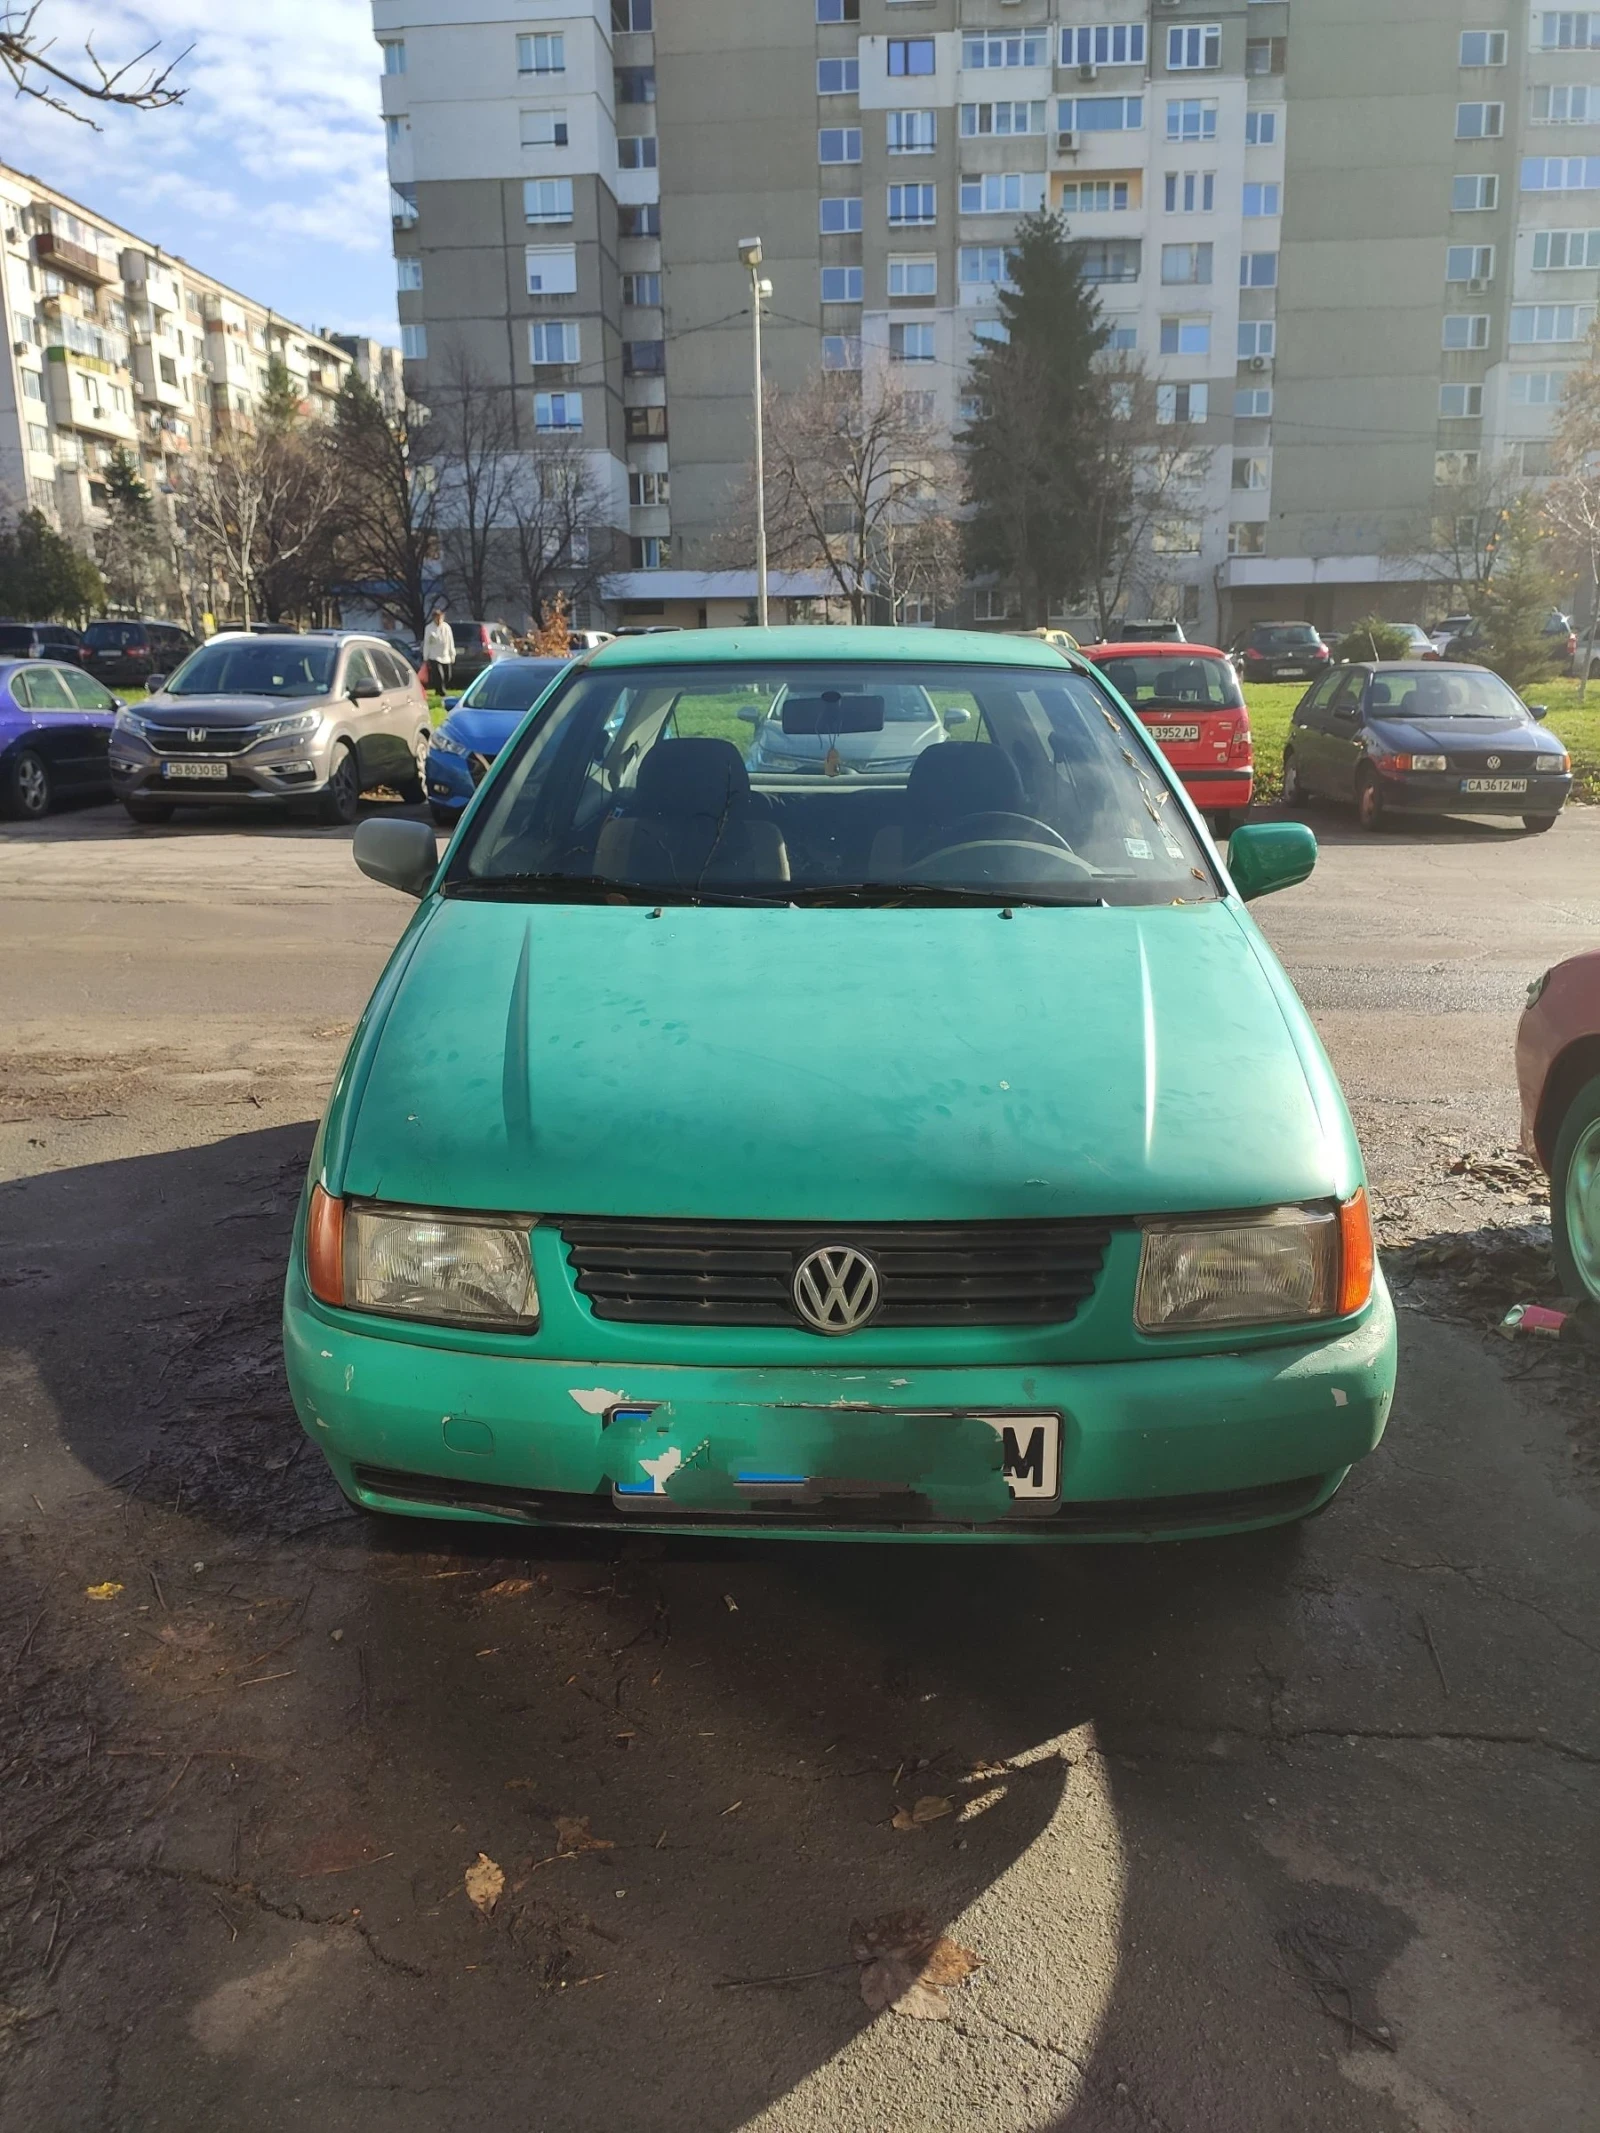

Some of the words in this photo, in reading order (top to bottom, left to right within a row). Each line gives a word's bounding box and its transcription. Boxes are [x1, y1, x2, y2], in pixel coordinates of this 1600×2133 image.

[1155, 727, 1181, 738] 3952
[1183, 727, 1197, 738] AP
[1487, 755, 1501, 769] VW
[170, 765, 183, 775] CB
[185, 765, 210, 775] 8030
[211, 765, 225, 775] BE
[1468, 780, 1482, 791] CA
[1484, 780, 1510, 791] 3612
[1511, 780, 1525, 791] MH
[794, 1246, 879, 1332] VW
[1002, 1426, 1045, 1487] M
